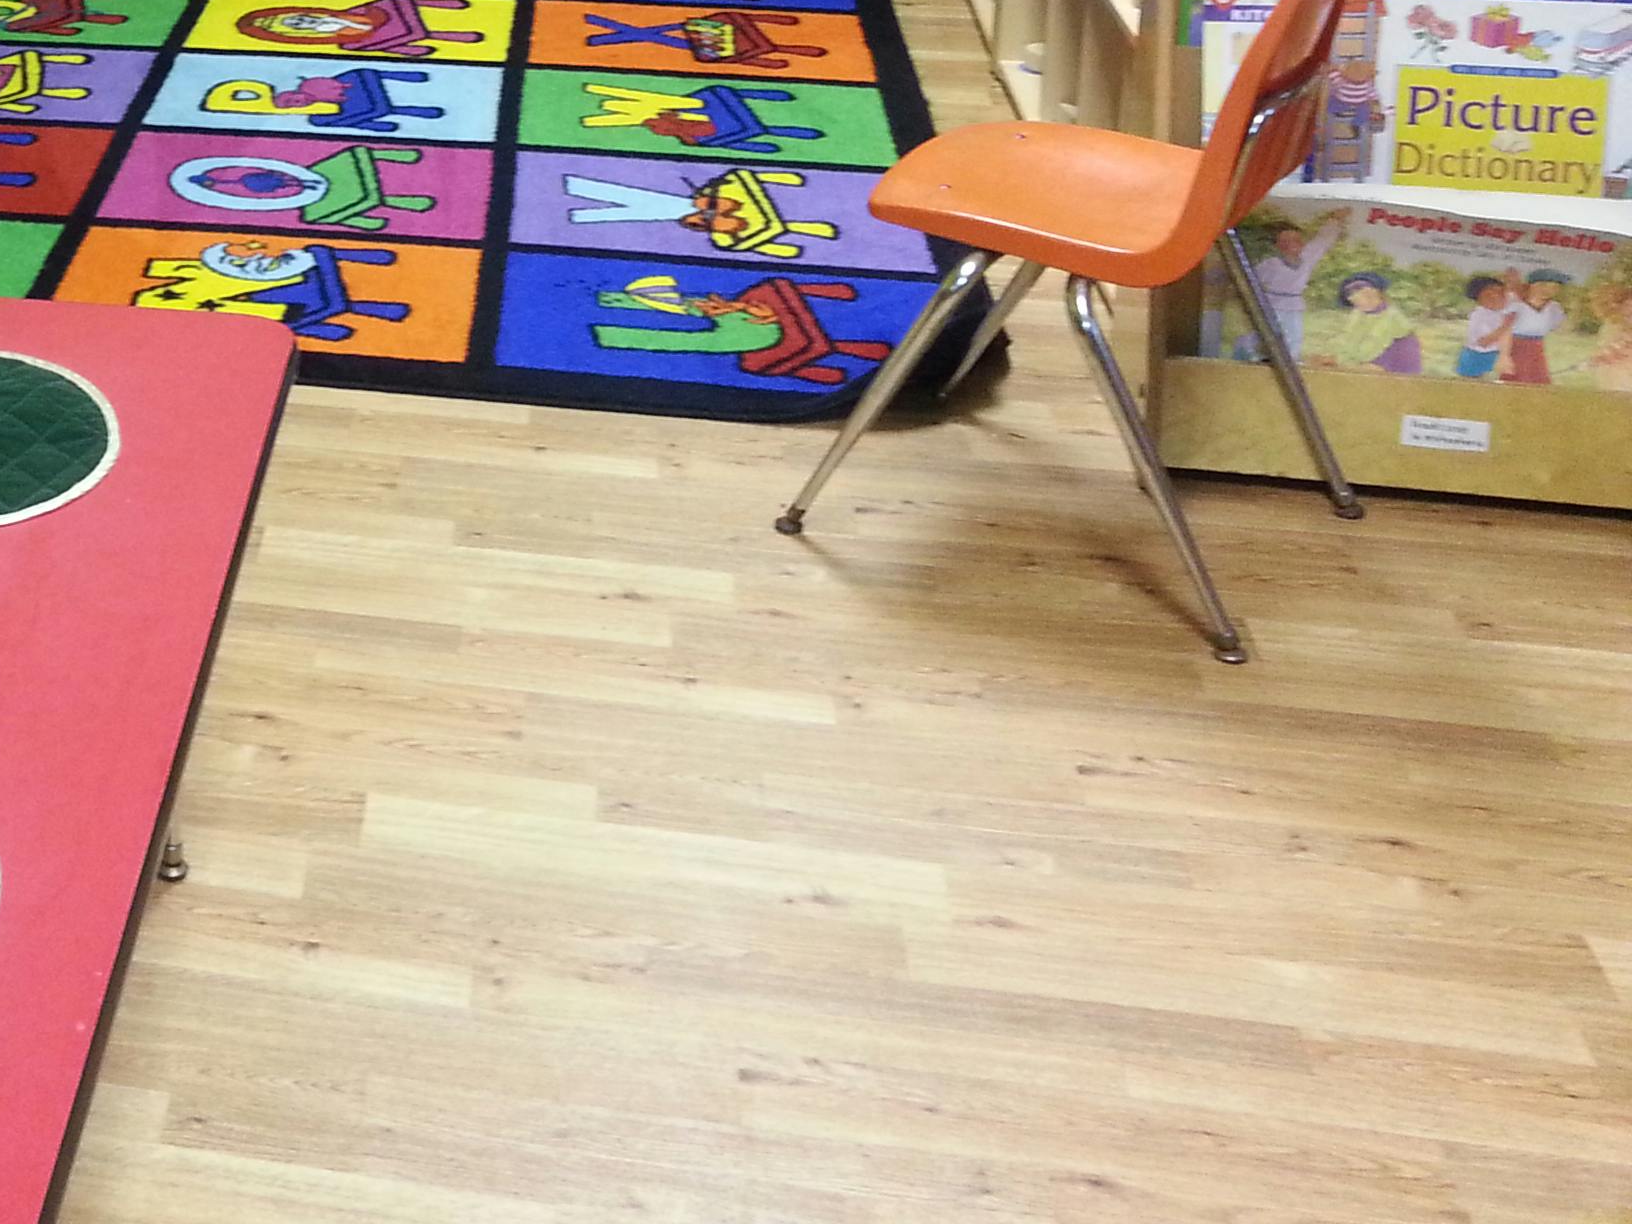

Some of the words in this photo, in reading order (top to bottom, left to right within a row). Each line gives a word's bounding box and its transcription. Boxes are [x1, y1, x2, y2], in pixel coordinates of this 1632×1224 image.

[584, 12, 698, 52] X
[199, 79, 342, 116] P
[1407, 85, 1599, 136] Picture
[1393, 141, 1600, 194] Dictionary
[562, 172, 703, 225] V
[1367, 207, 1463, 234] People
[1470, 221, 1526, 244] Say
[1535, 228, 1615, 254] Hello
